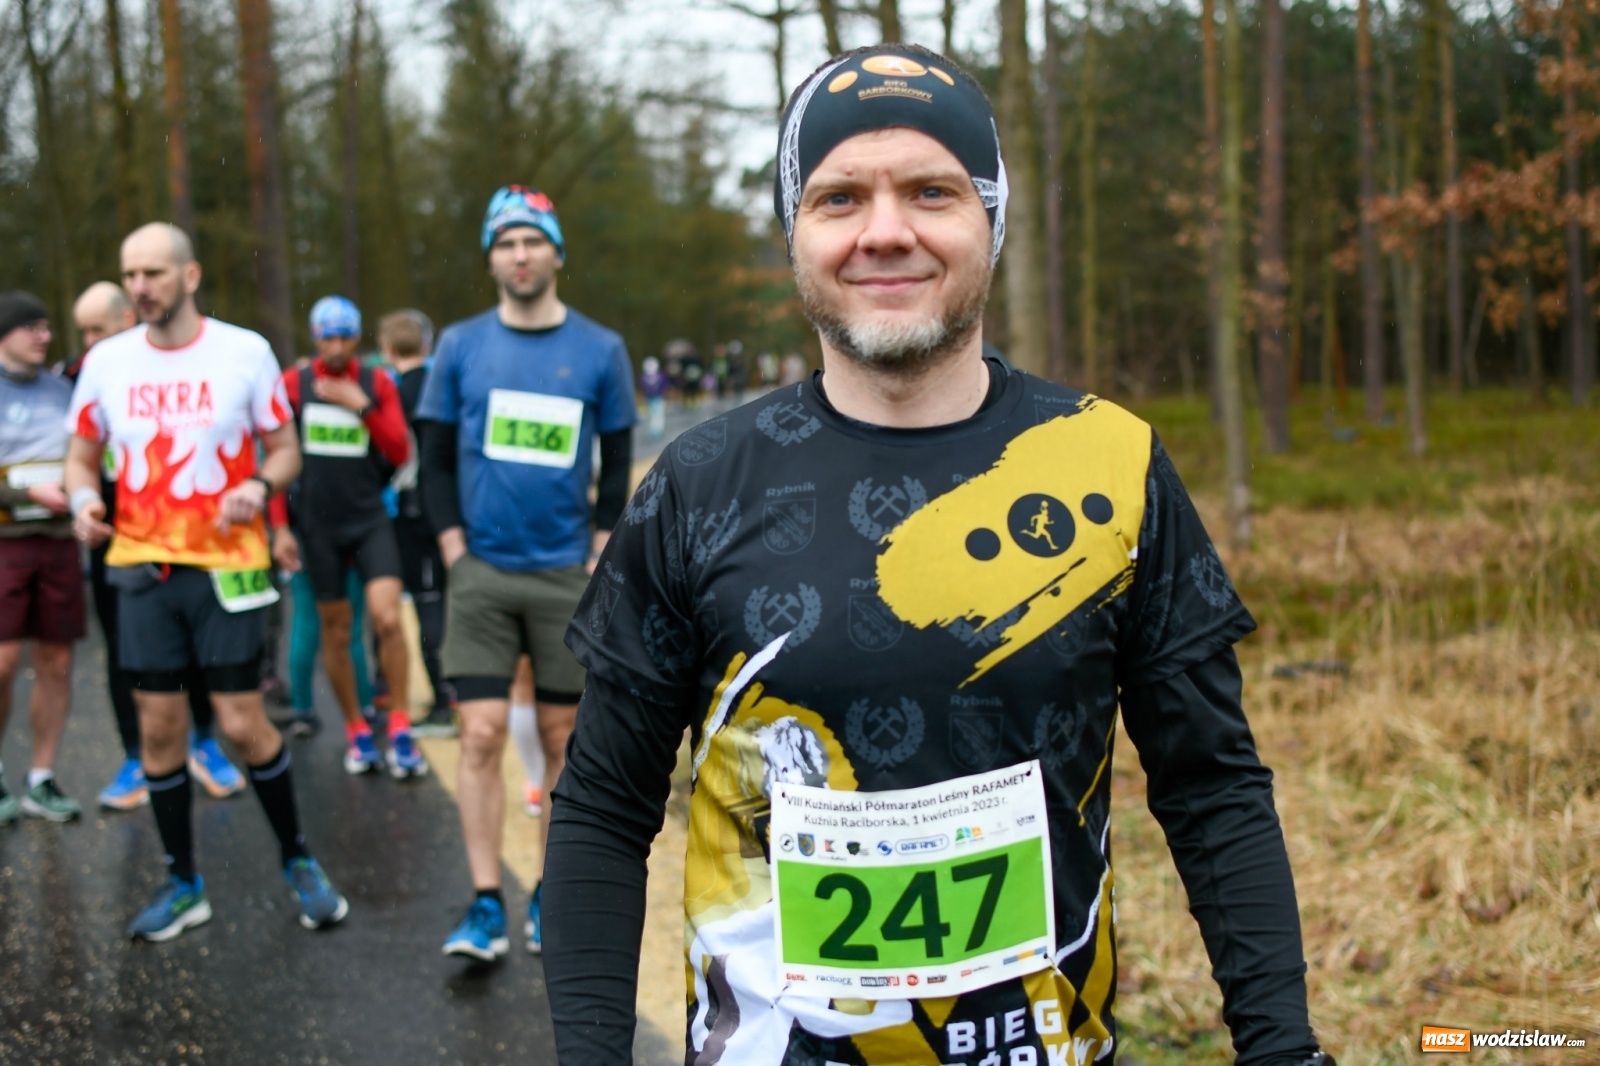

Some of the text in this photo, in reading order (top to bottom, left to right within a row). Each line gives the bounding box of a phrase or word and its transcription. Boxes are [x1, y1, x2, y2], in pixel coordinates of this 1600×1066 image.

[128, 382, 212, 417] ISKRA
[506, 421, 562, 452] 136
[765, 481, 816, 498] Rybnik
[950, 694, 1004, 708] Rybnik
[786, 774, 1025, 812] VIII Kuźniański Półmaraton Leśny RAFAMET
[804, 813, 838, 827] Kuźnia
[841, 815, 910, 828] Raciborska,
[922, 804, 969, 823] kwietnia
[972, 796, 1000, 812] 2023
[814, 854, 1009, 962] 247
[947, 999, 1063, 1056] BIEG
